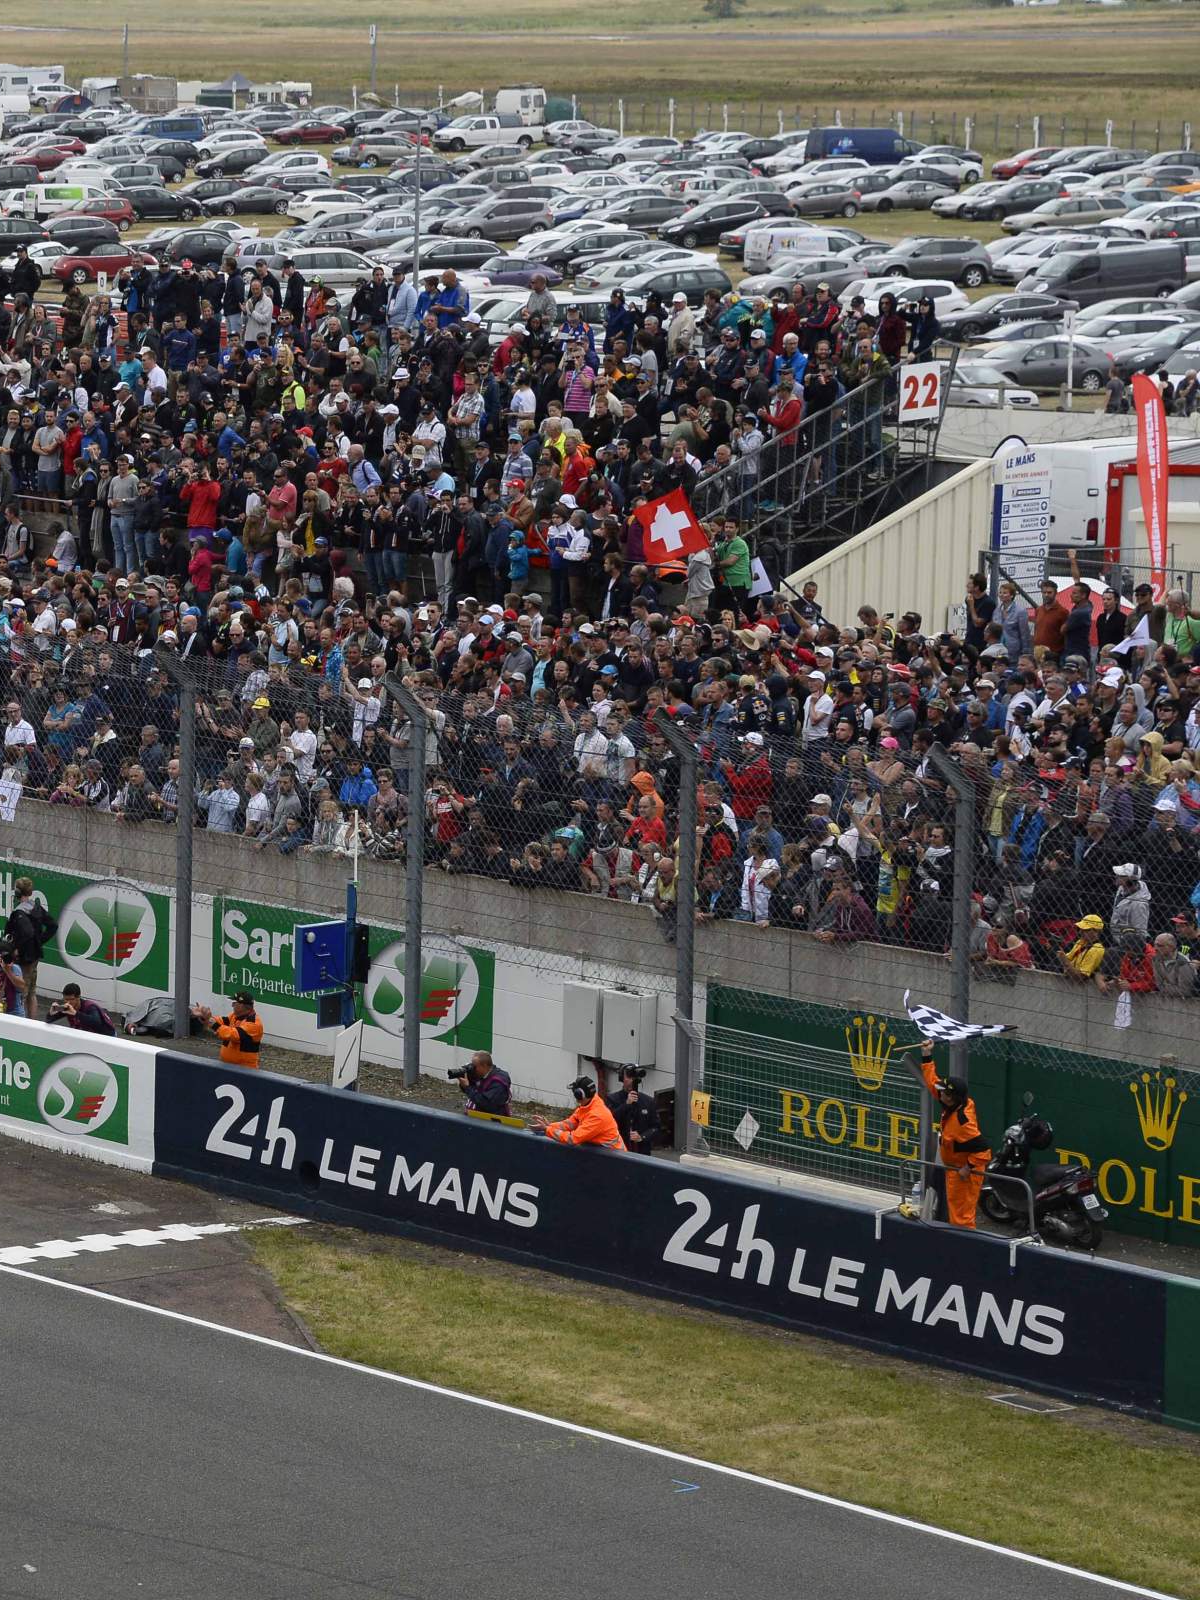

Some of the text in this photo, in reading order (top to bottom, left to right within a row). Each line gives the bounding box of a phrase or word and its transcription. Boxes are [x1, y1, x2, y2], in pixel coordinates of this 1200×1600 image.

[902, 372, 938, 410] 22
[1006, 452, 1036, 469] LE MANS
[221, 964, 238, 984] Le
[778, 1089, 943, 1161] ROLE
[205, 1084, 540, 1228] 24h LE MANS
[663, 1189, 1065, 1356] 24h LE MANS
